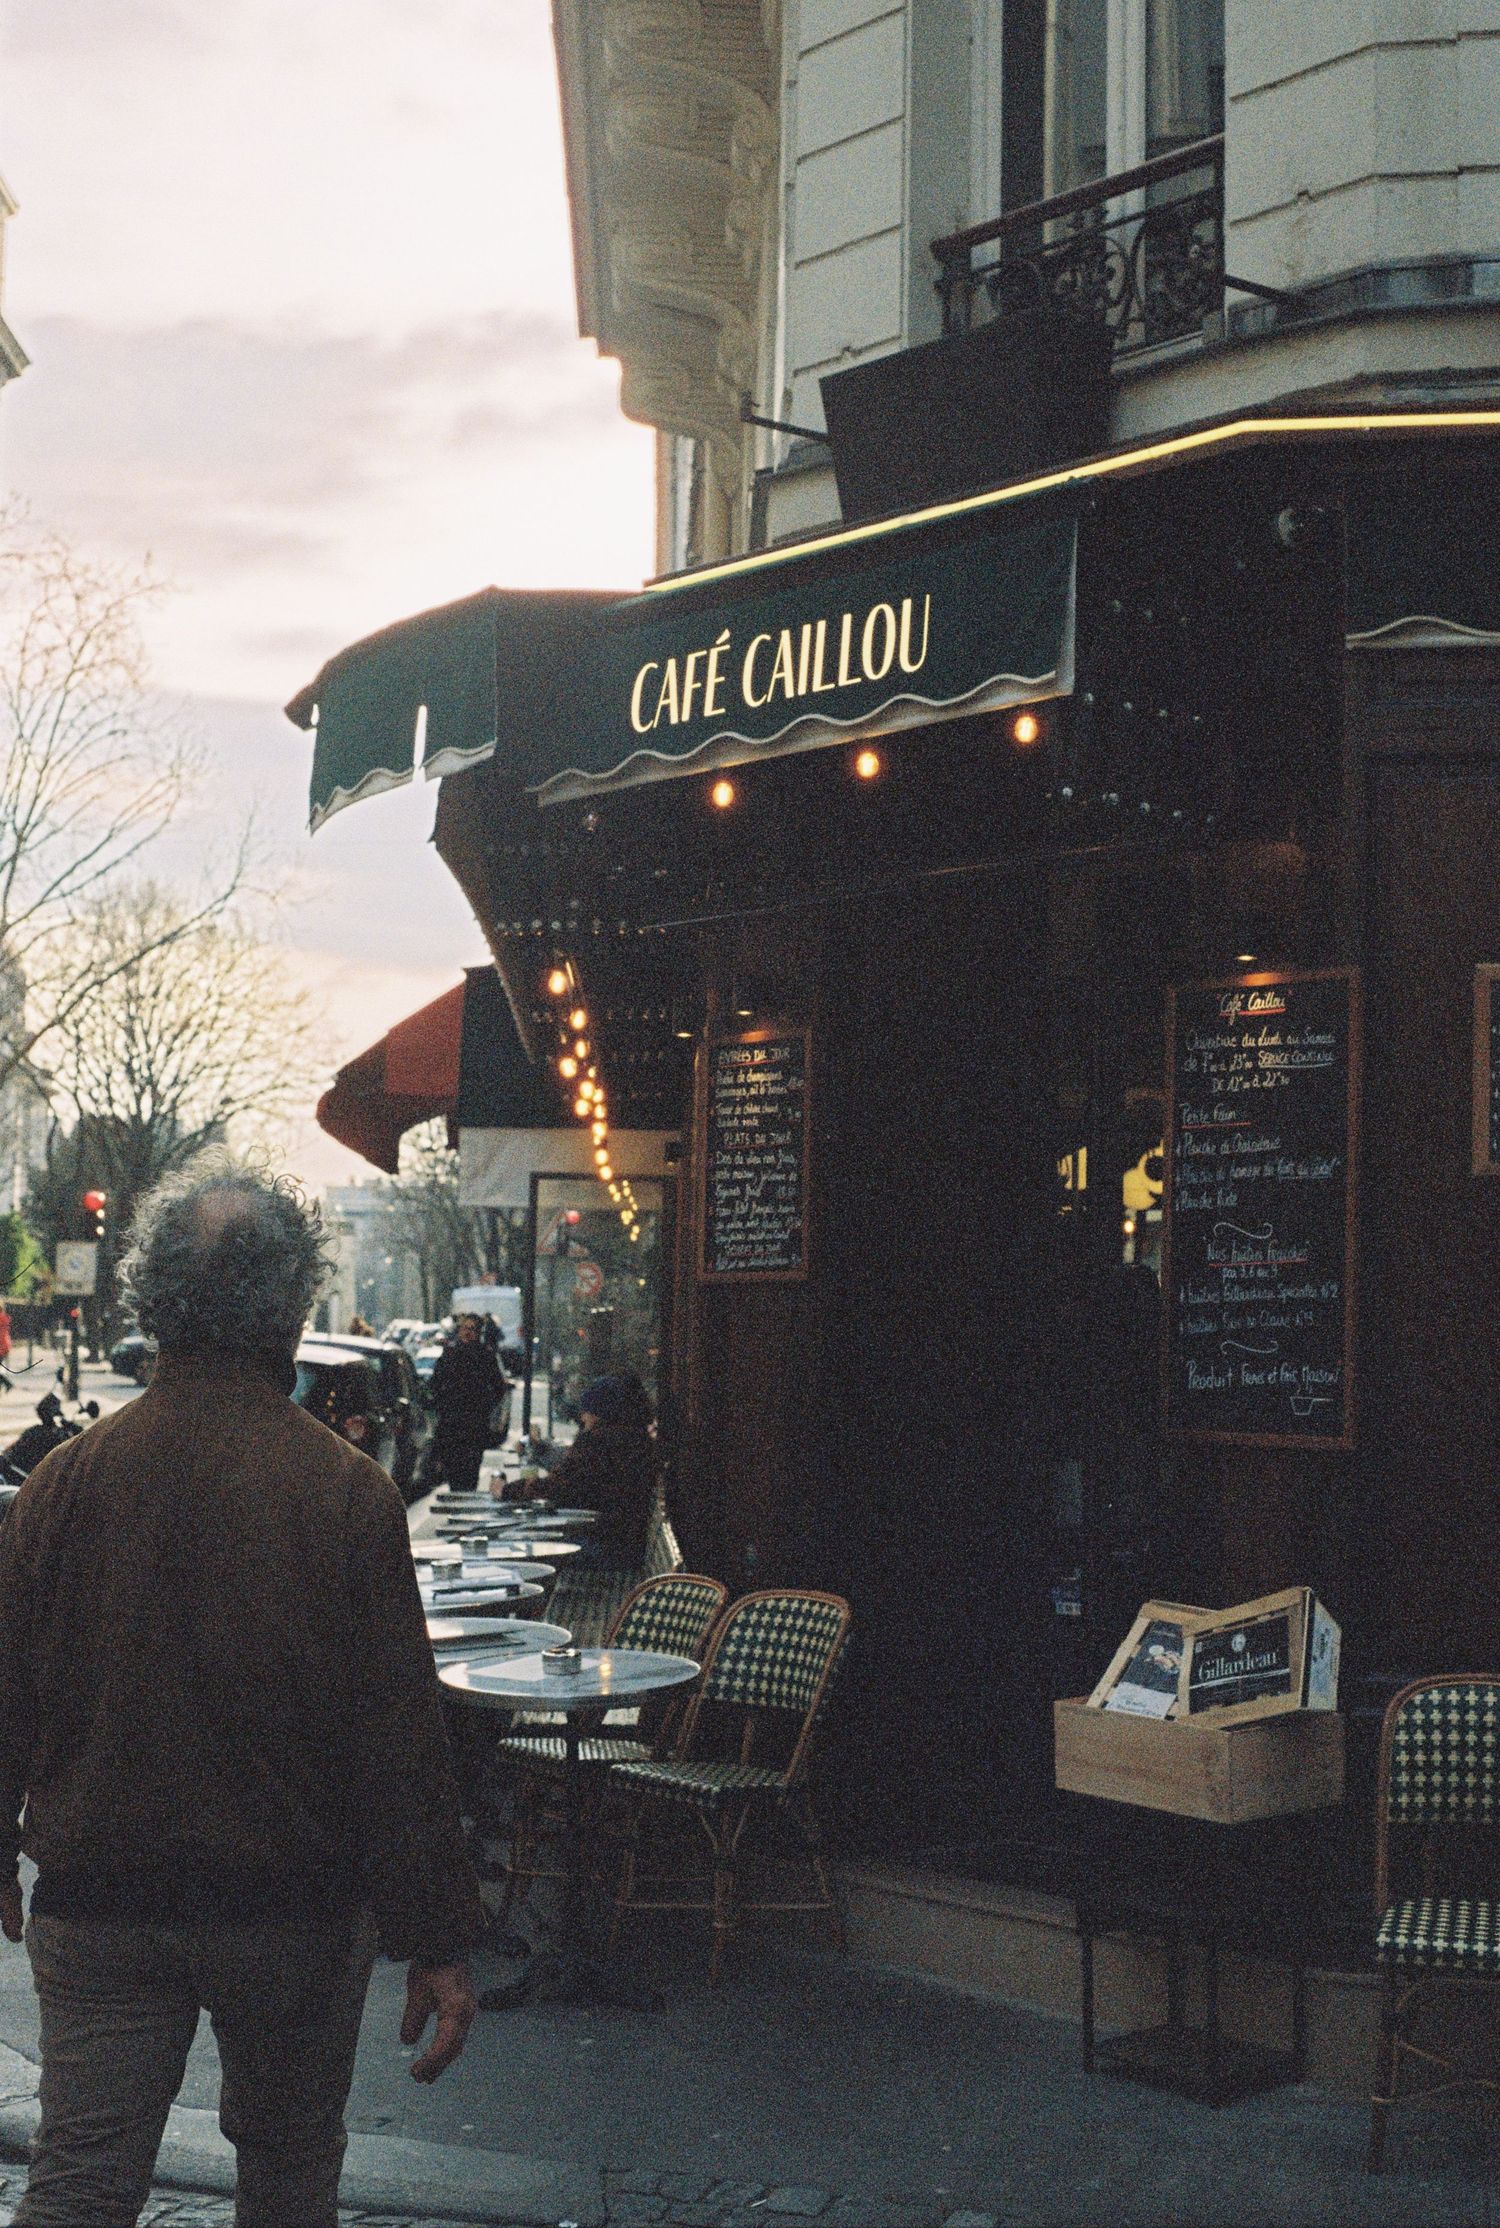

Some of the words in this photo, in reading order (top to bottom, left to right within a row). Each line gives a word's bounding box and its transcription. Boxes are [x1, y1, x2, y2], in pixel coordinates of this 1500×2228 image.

[630, 628, 731, 733] CAFÉ
[742, 594, 931, 708] CAILLOU
[1247, 990, 1286, 1012] Caillou
[1241, 1032, 1256, 1048] du
